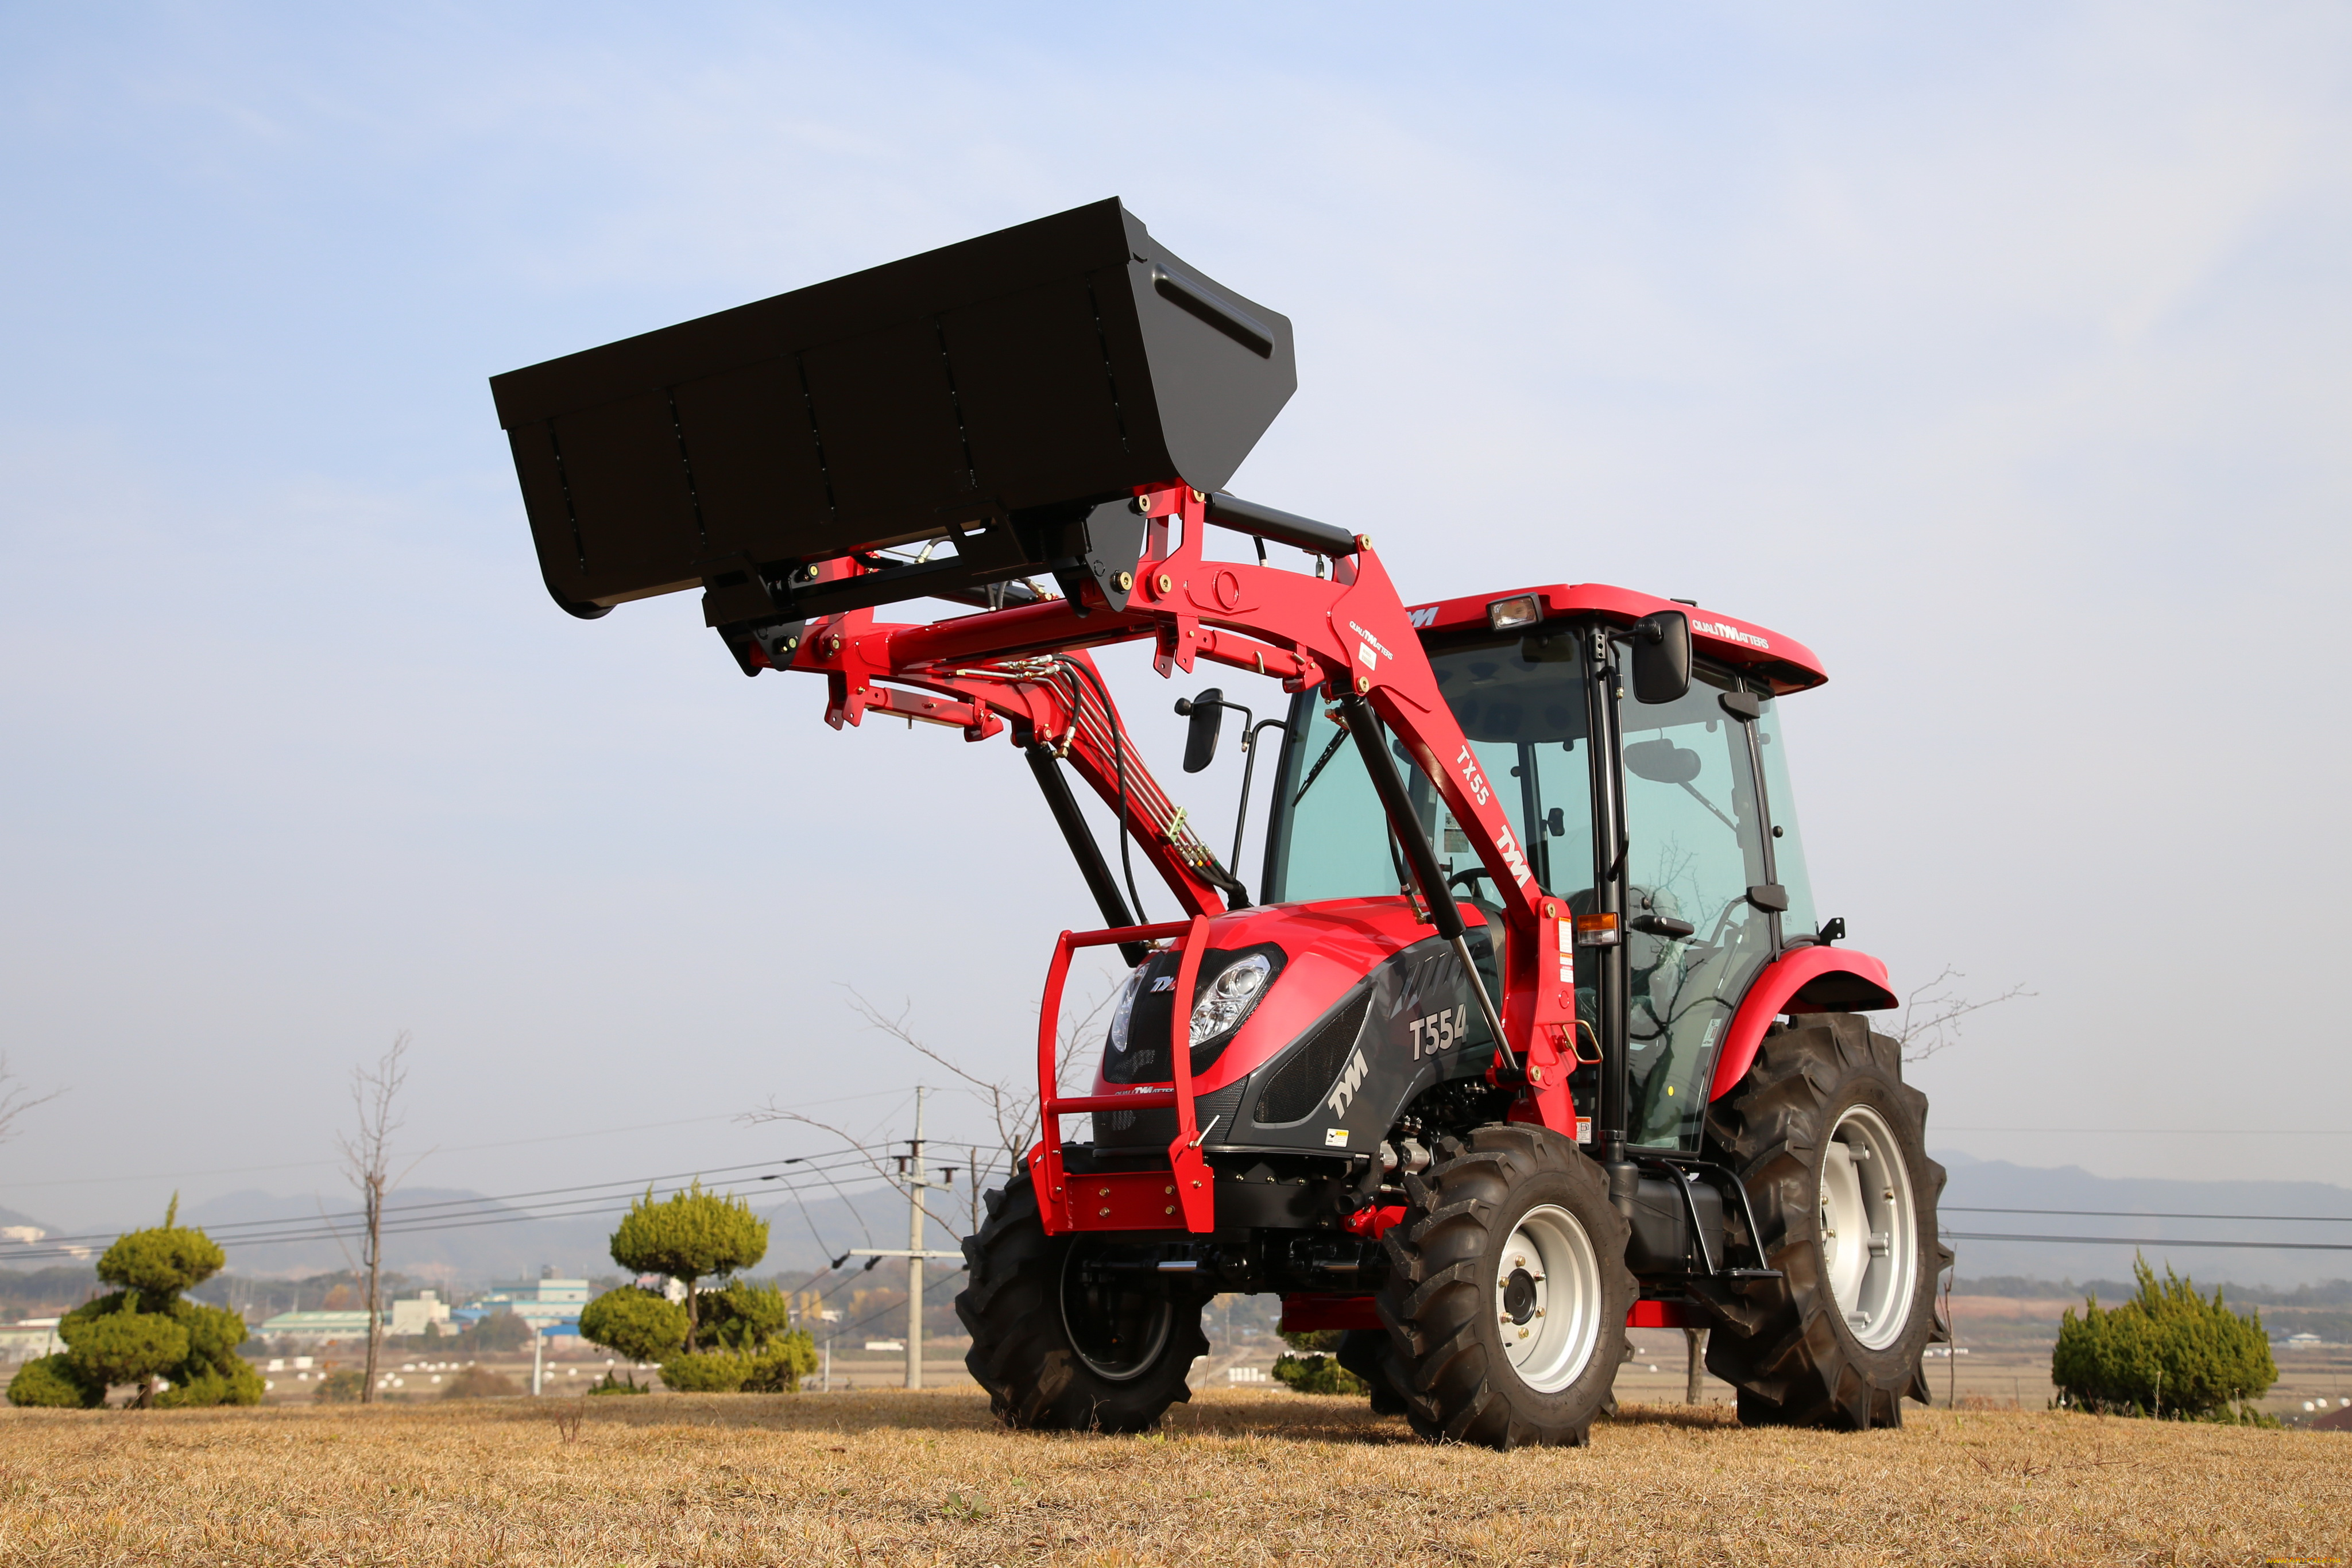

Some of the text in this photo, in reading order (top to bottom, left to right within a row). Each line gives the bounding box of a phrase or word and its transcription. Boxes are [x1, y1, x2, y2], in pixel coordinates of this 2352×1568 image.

[1406, 606, 1440, 628] YM
[1456, 744, 1490, 806] TX55
[1496, 824, 1531, 889] TYM
[1410, 1003, 1469, 1061] T554
[1328, 1048, 1369, 1120] TYM
